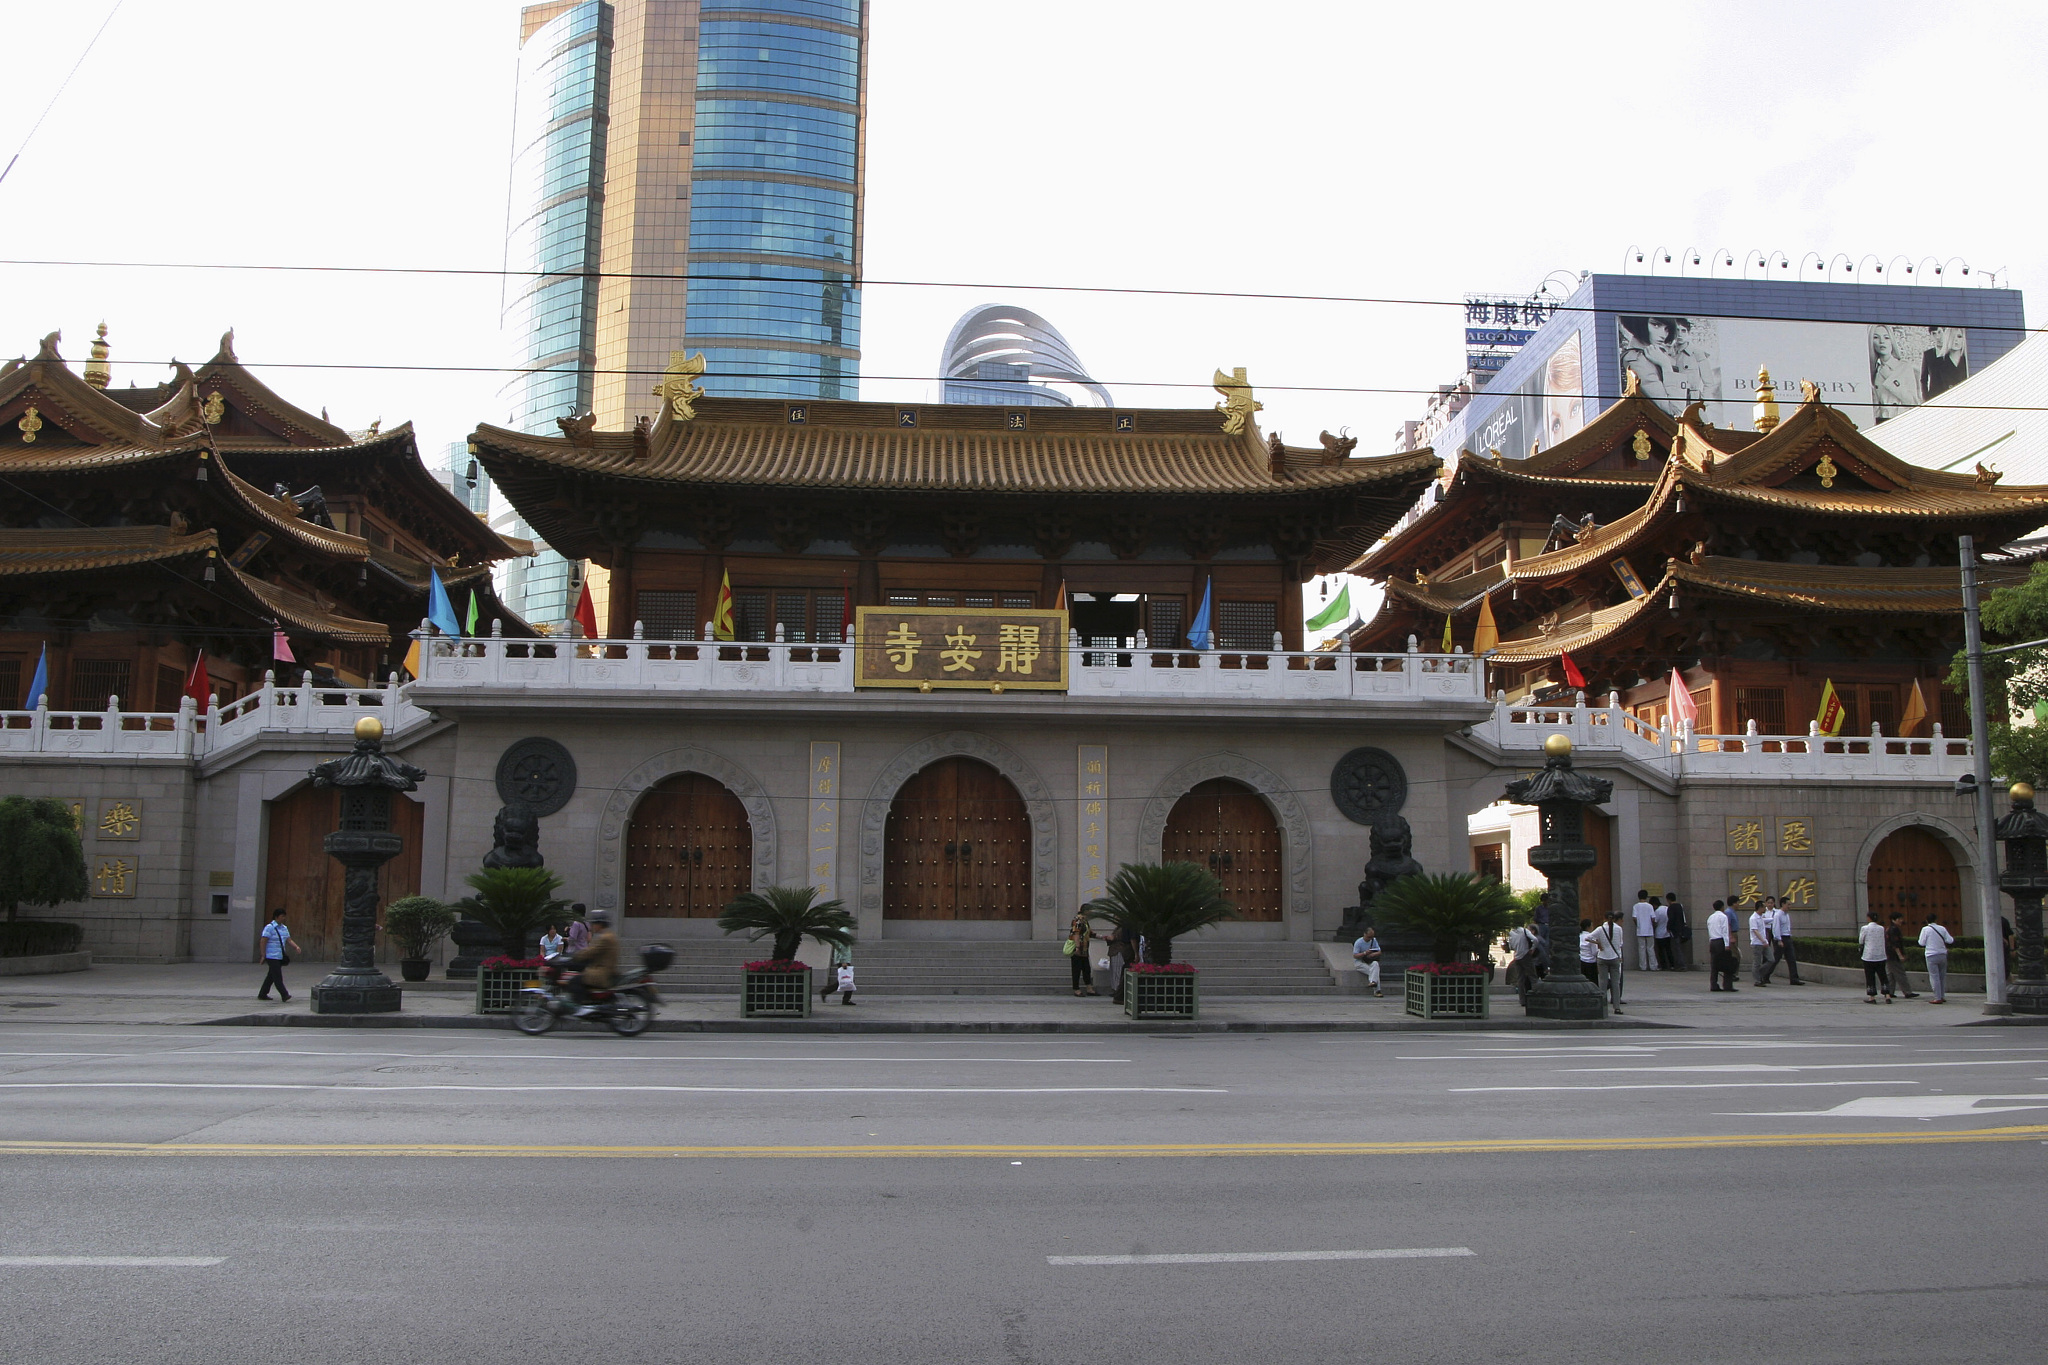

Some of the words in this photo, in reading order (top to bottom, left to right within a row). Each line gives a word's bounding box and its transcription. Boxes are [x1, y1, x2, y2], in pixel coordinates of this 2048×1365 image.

[1465, 298, 1564, 327] 海康保
[1734, 378, 1860, 393] BURBRRY
[1479, 406, 1518, 453] L'ORÉAL
